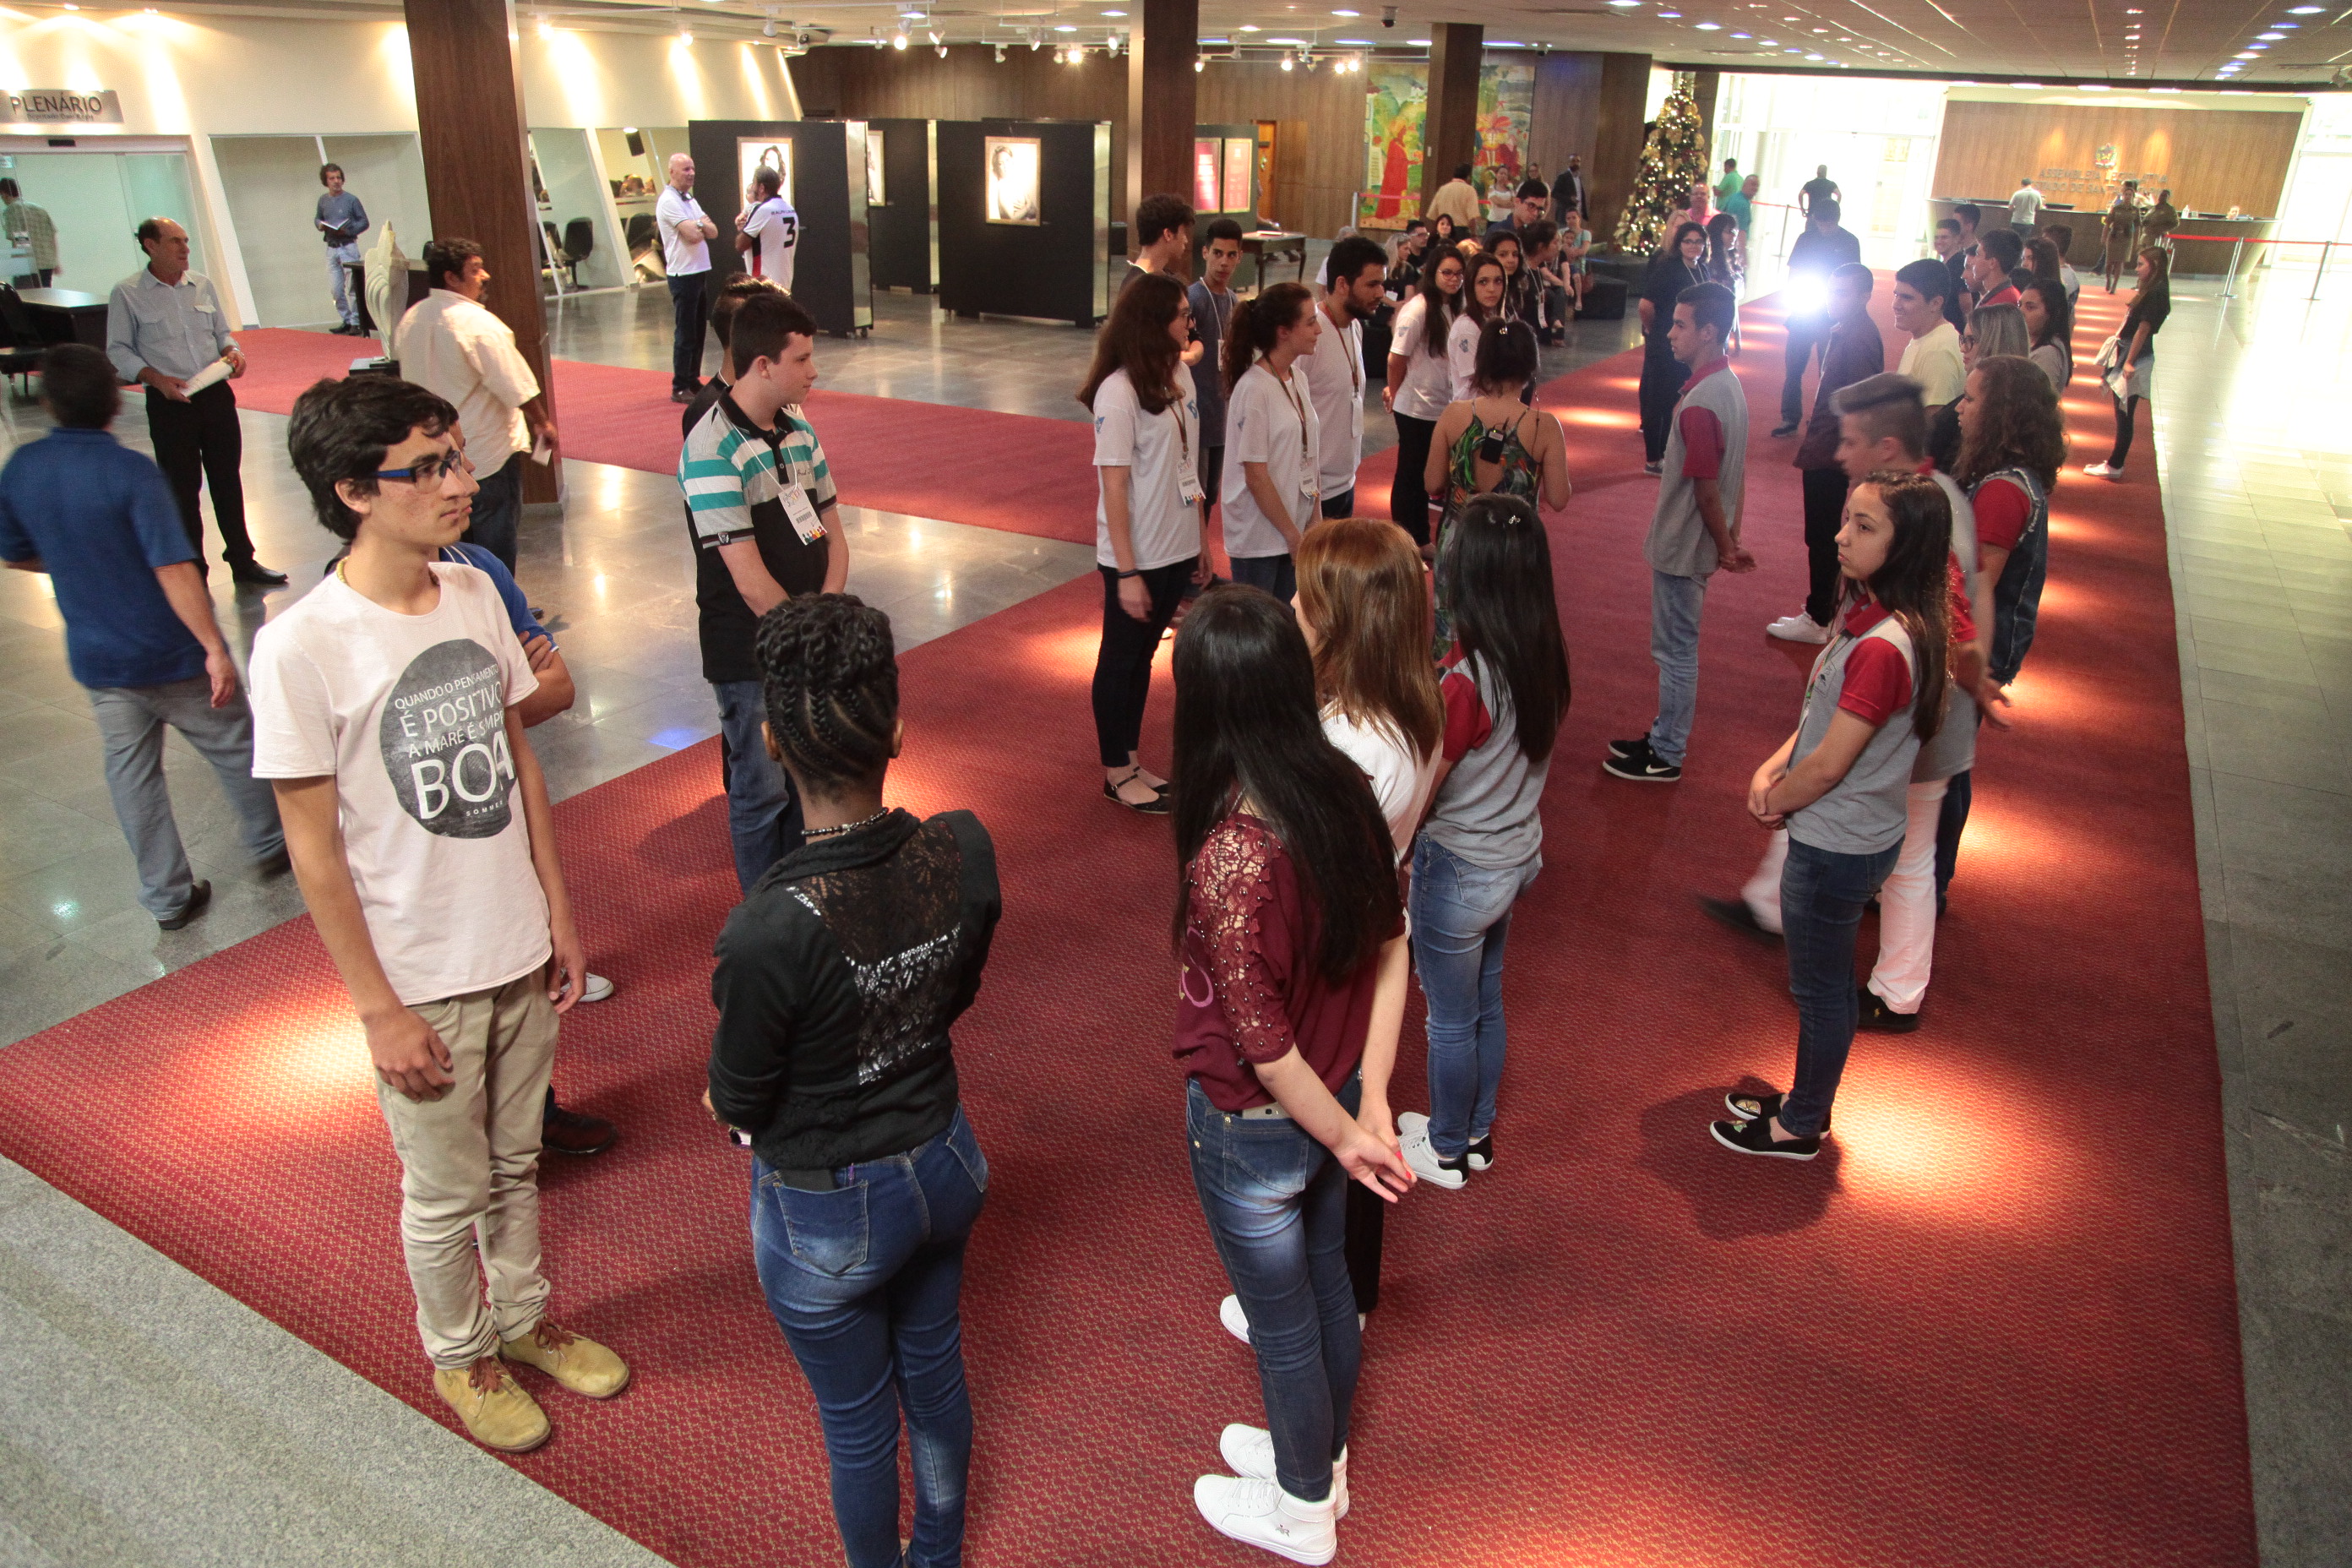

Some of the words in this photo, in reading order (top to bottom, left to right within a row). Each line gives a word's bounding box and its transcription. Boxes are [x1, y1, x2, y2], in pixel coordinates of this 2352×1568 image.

[9, 92, 102, 114] PLENÁRIO
[782, 216, 796, 249] 3
[395, 686, 444, 710] QUANDO
[444, 683, 454, 694] O
[400, 710, 418, 738] É
[422, 681, 503, 733] POSITIVO
[408, 743, 422, 759] A
[424, 727, 466, 755] MARÉ
[467, 721, 476, 739] É
[411, 730, 514, 819] BOA
